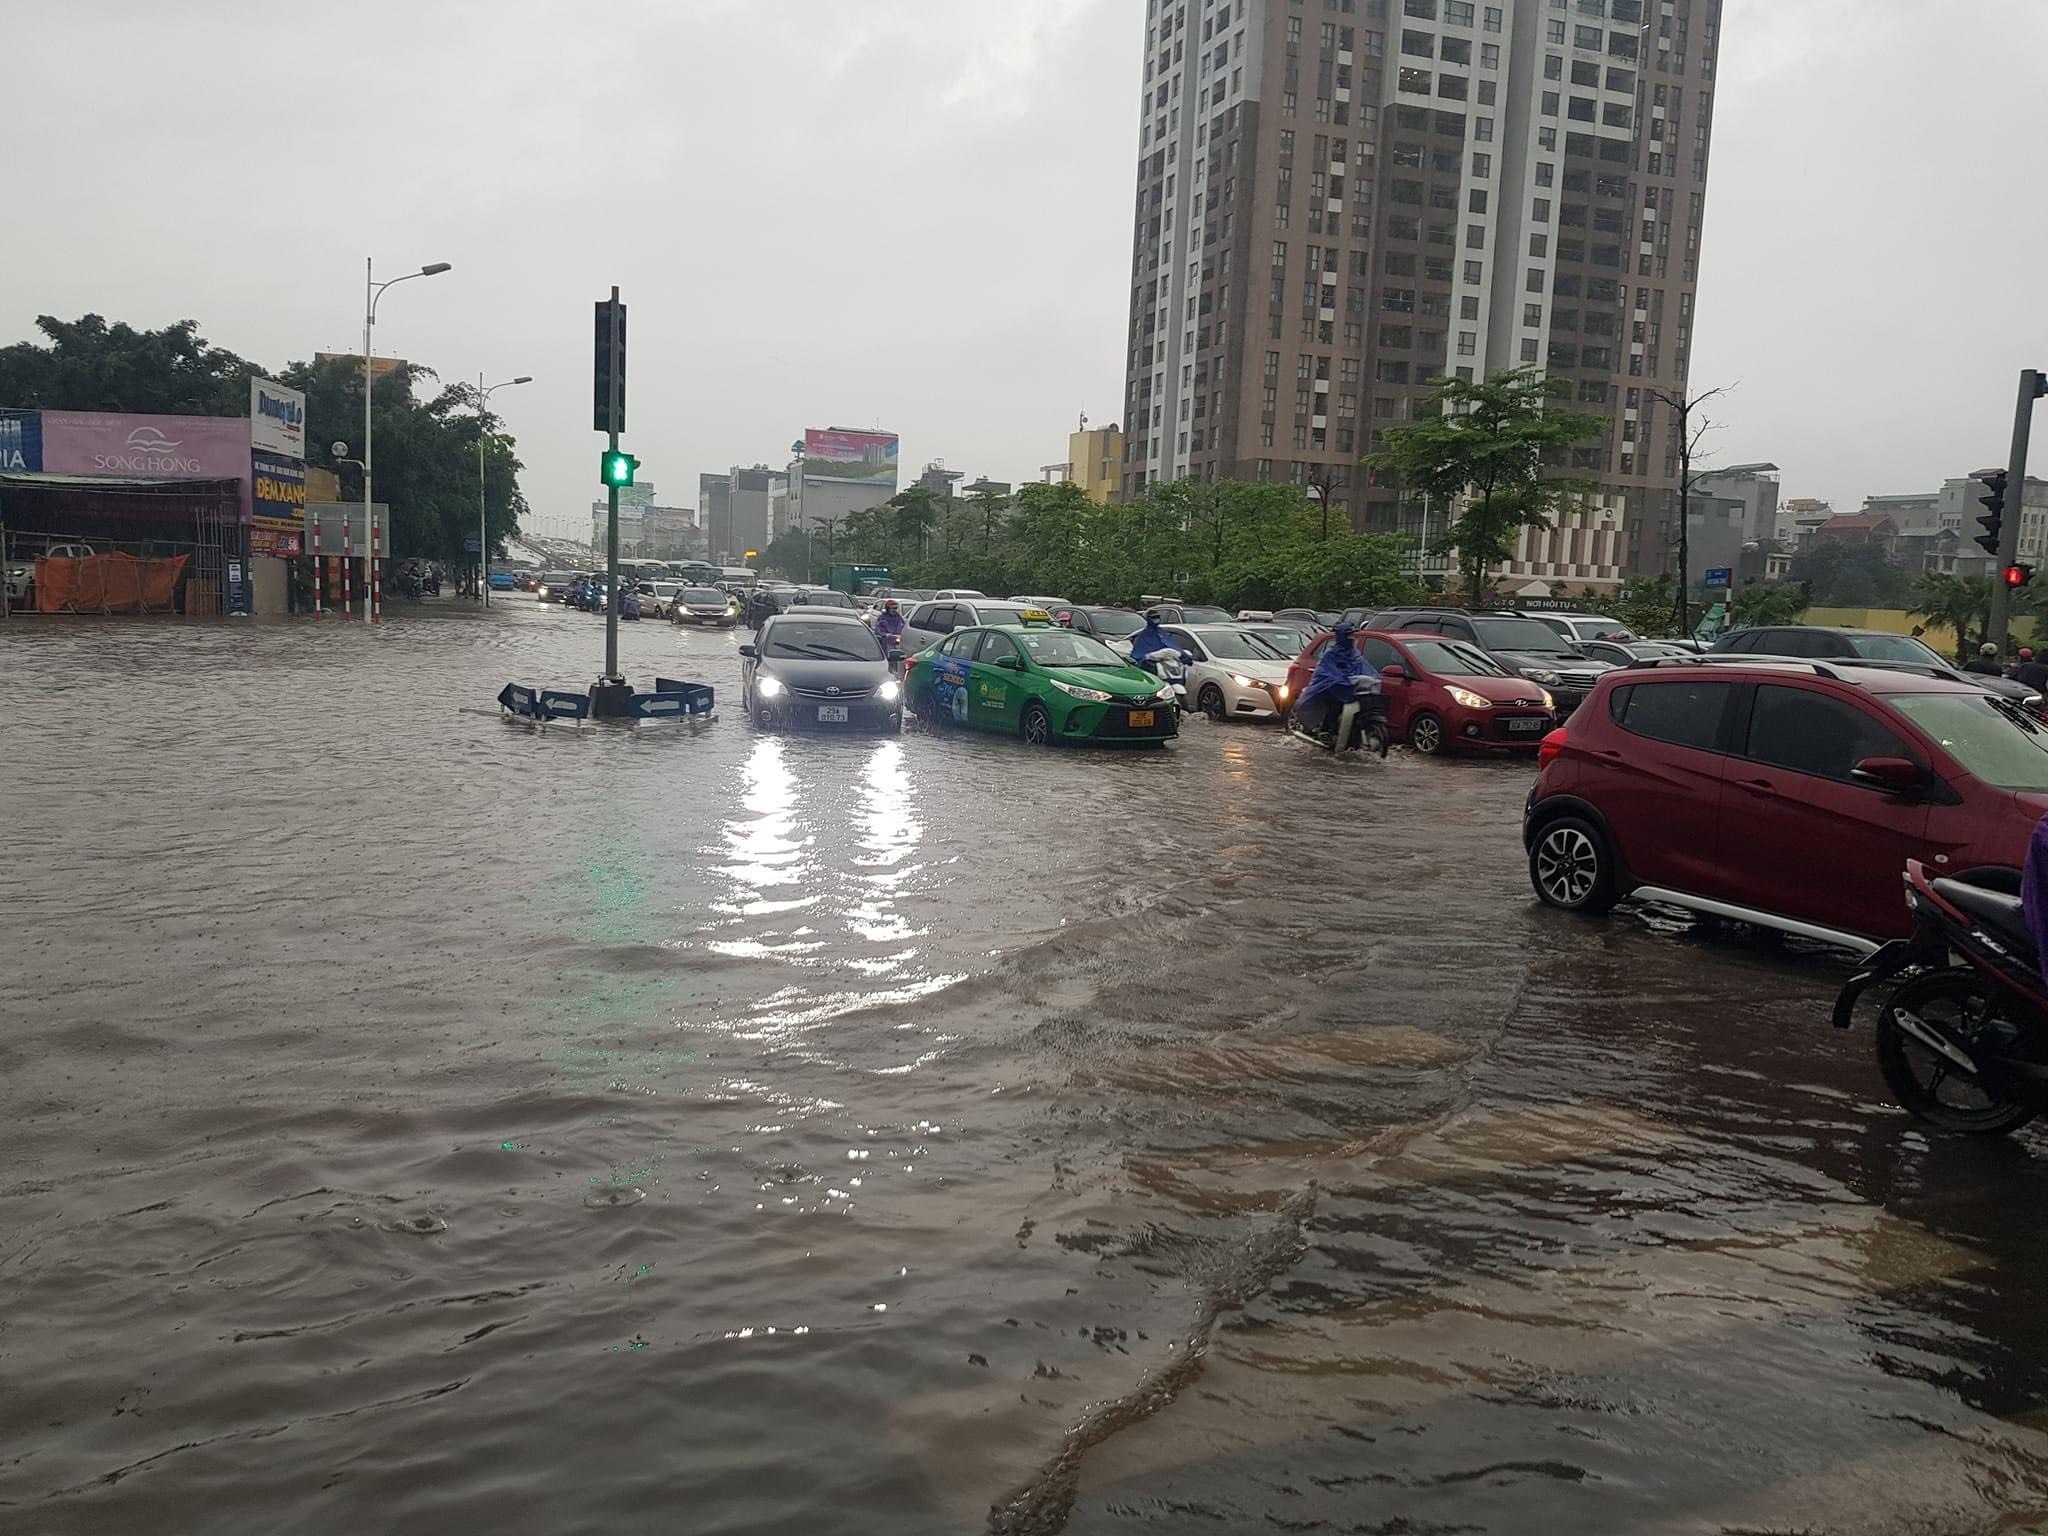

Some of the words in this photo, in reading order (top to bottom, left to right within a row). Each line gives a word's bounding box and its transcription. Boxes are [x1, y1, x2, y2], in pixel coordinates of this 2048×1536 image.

[0, 449, 27, 468] IA
[95, 454, 144, 470] SONG
[149, 456, 200, 473] HONG
